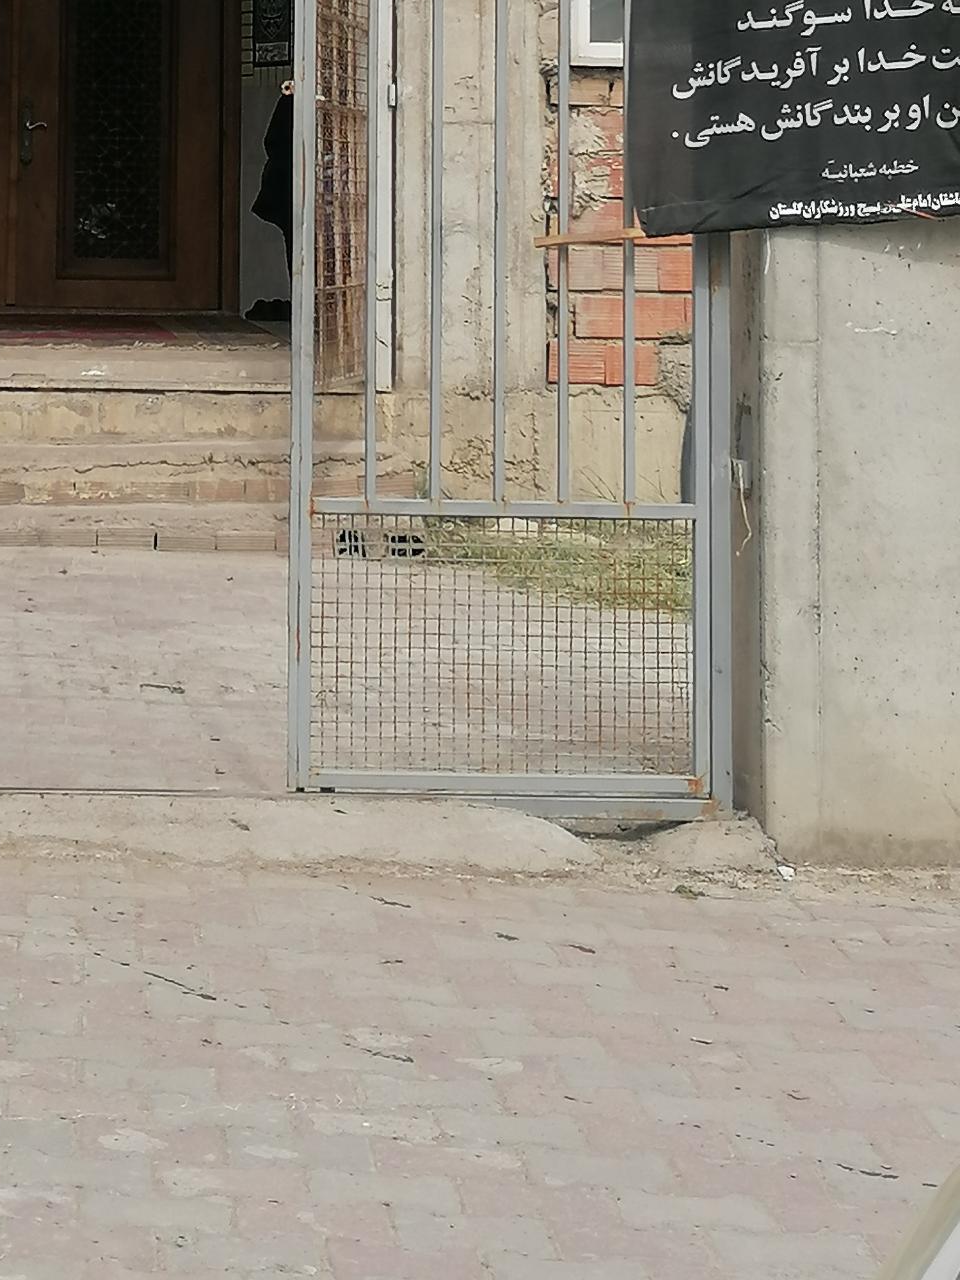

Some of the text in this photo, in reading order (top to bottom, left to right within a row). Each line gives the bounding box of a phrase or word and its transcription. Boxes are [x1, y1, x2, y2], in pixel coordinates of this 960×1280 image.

[826, 55, 850, 86] بر
[857, 42, 928, 73] خدا
[876, 102, 901, 133] بر
[878, 159, 920, 181] خطبه
